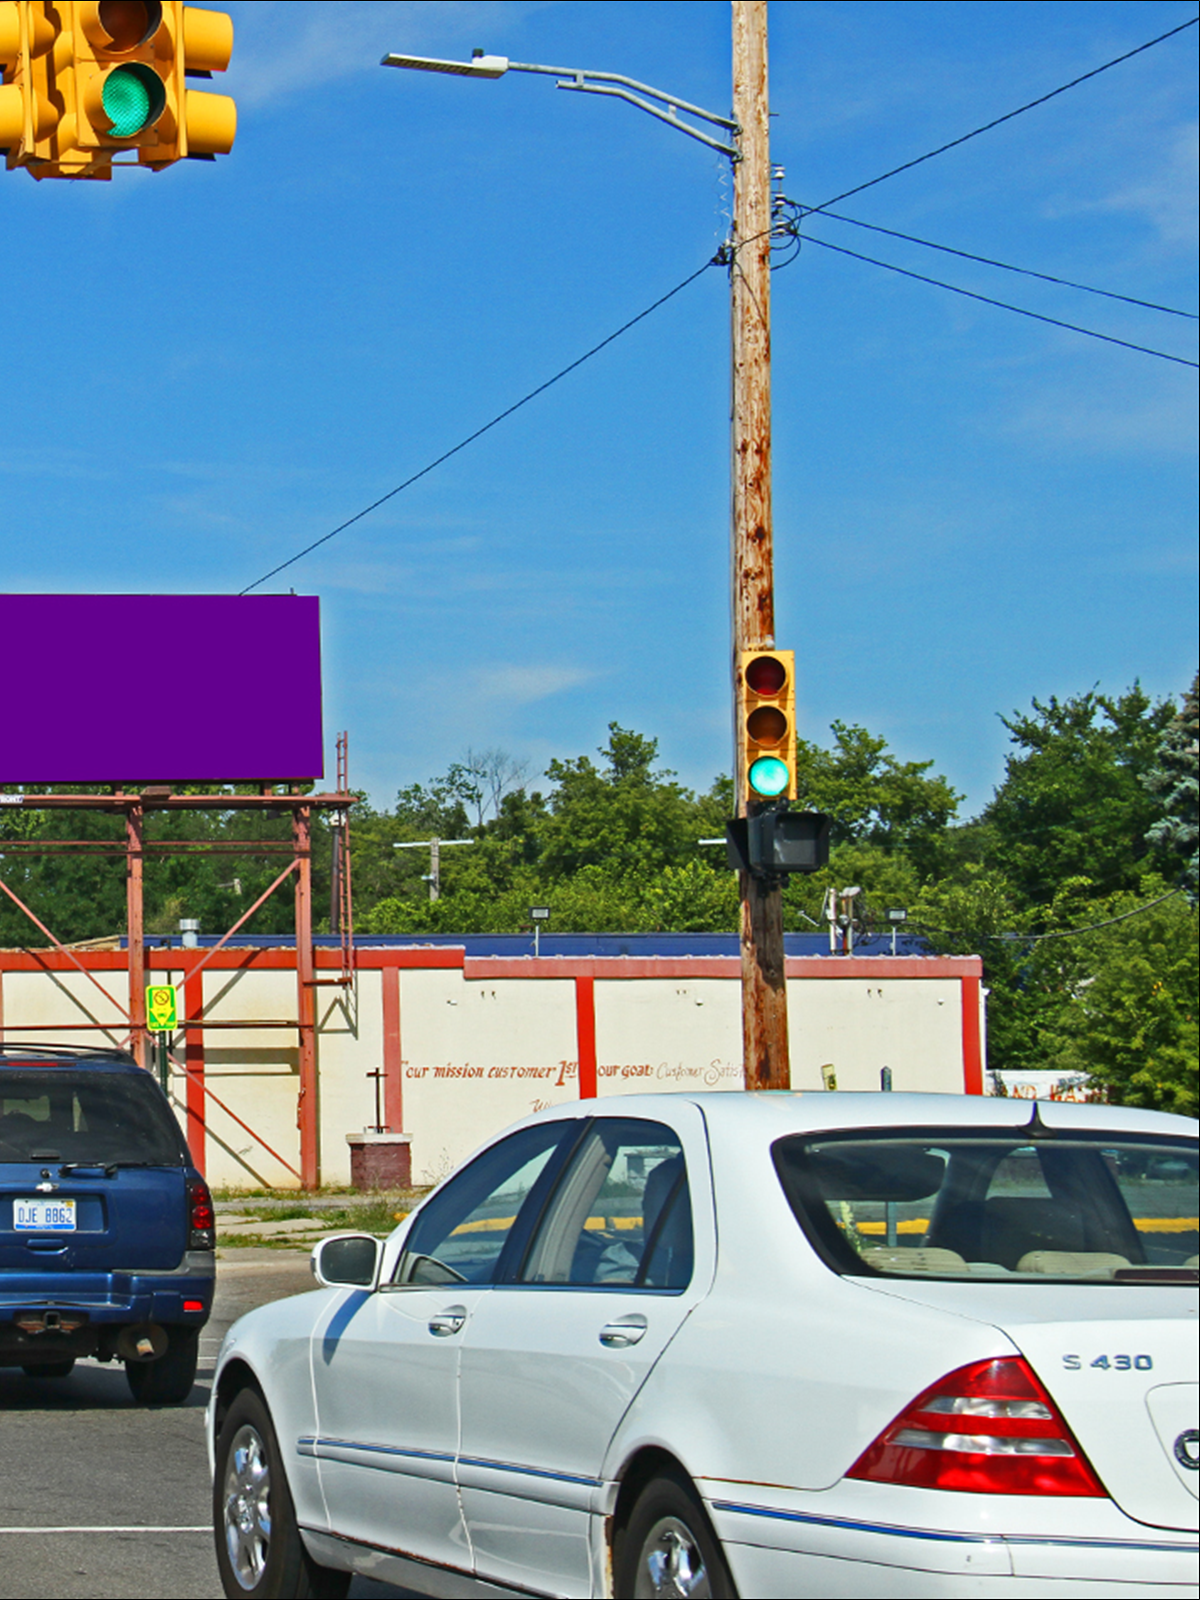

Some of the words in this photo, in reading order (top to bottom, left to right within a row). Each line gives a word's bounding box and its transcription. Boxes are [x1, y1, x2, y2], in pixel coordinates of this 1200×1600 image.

[45, 1207, 73, 1223] 8862
[1062, 1354, 1082, 1370] S
[1090, 1354, 1153, 1371] 430
